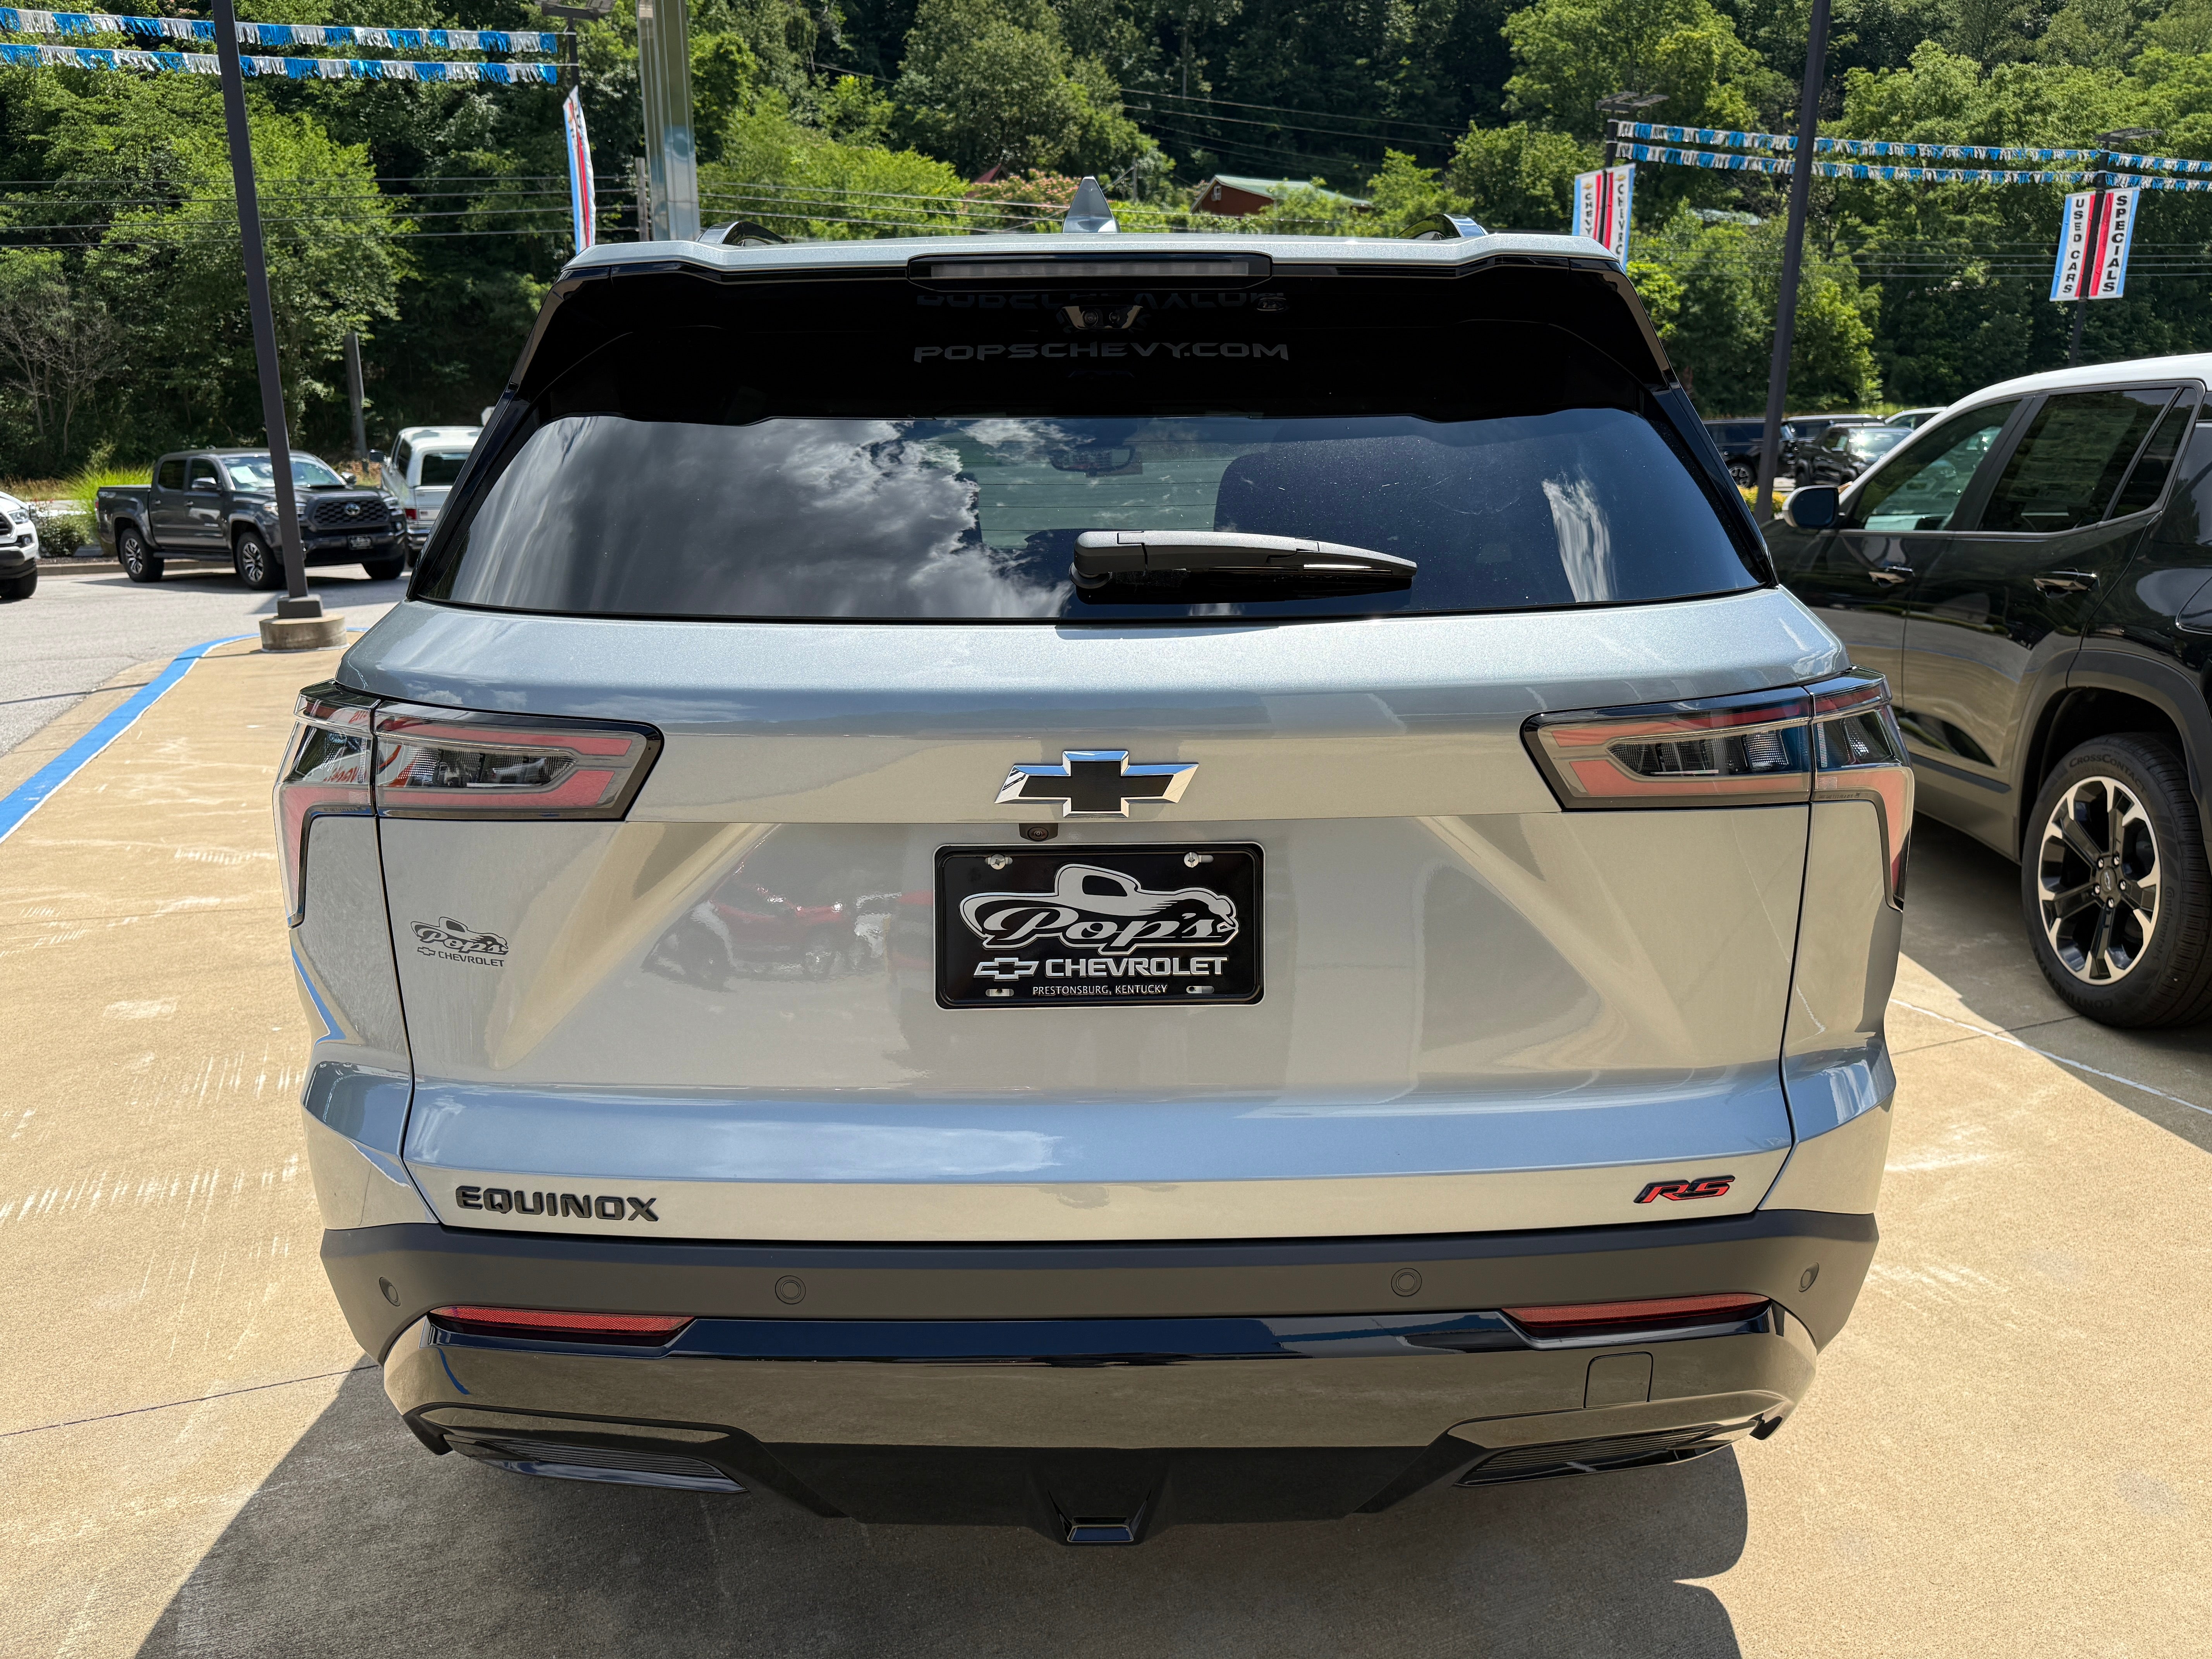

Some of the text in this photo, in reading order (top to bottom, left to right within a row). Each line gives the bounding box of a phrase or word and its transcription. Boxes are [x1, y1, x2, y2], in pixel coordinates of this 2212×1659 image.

[1585, 192, 1594, 235] CHEVY
[2062, 198, 2085, 293] USED CARS
[2102, 195, 2128, 292] SPECIALS
[914, 342, 1289, 363] POPSCHEVY.COM
[417, 928, 502, 953] Pop's
[981, 906, 1222, 948] Pop's
[438, 951, 505, 967] CHEVROLET
[1044, 957, 1228, 978] CHEVROLET
[1032, 984, 1168, 996] PRESTONSBURG, KENTUCKY
[455, 1185, 659, 1222] EQUINOX
[1633, 1175, 1736, 1204] RS
